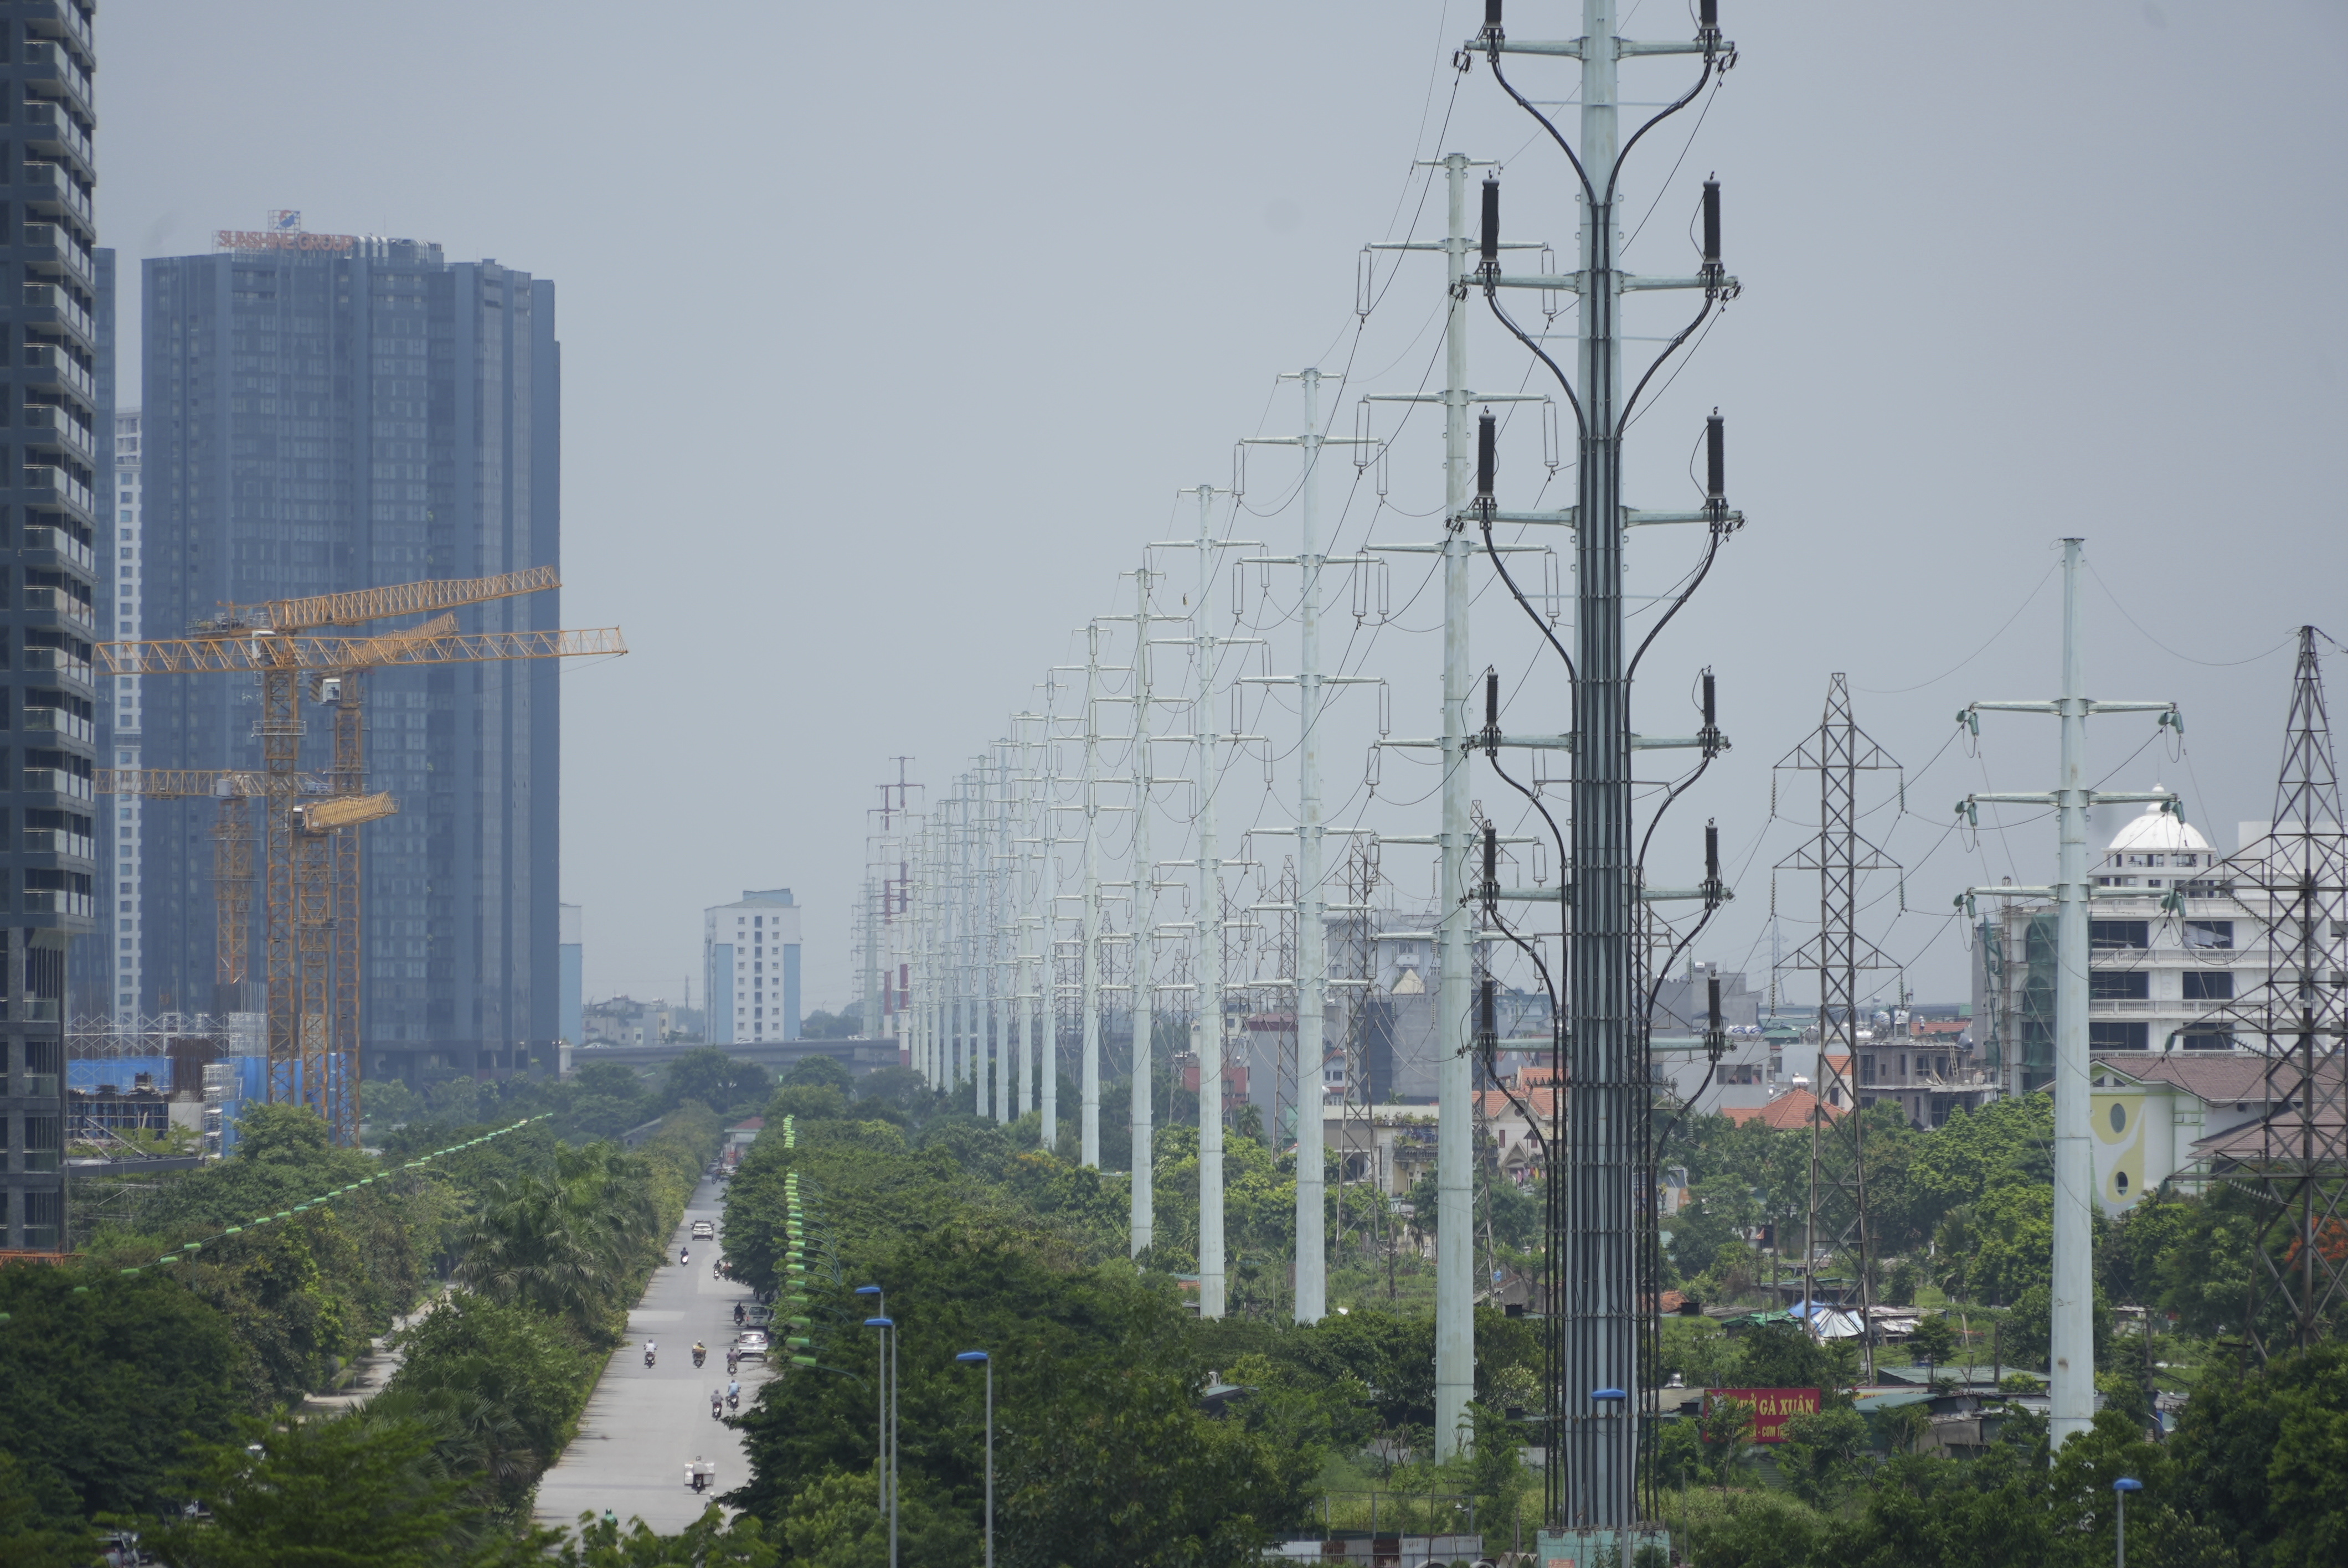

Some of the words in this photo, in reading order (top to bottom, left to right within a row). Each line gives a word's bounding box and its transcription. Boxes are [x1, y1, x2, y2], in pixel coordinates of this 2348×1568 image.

[219, 230, 296, 250] SUNSHINE
[298, 233, 353, 251] GROUP
[1759, 1394, 1777, 1416] GÀ
[1779, 1394, 1815, 1415] XUÂN
